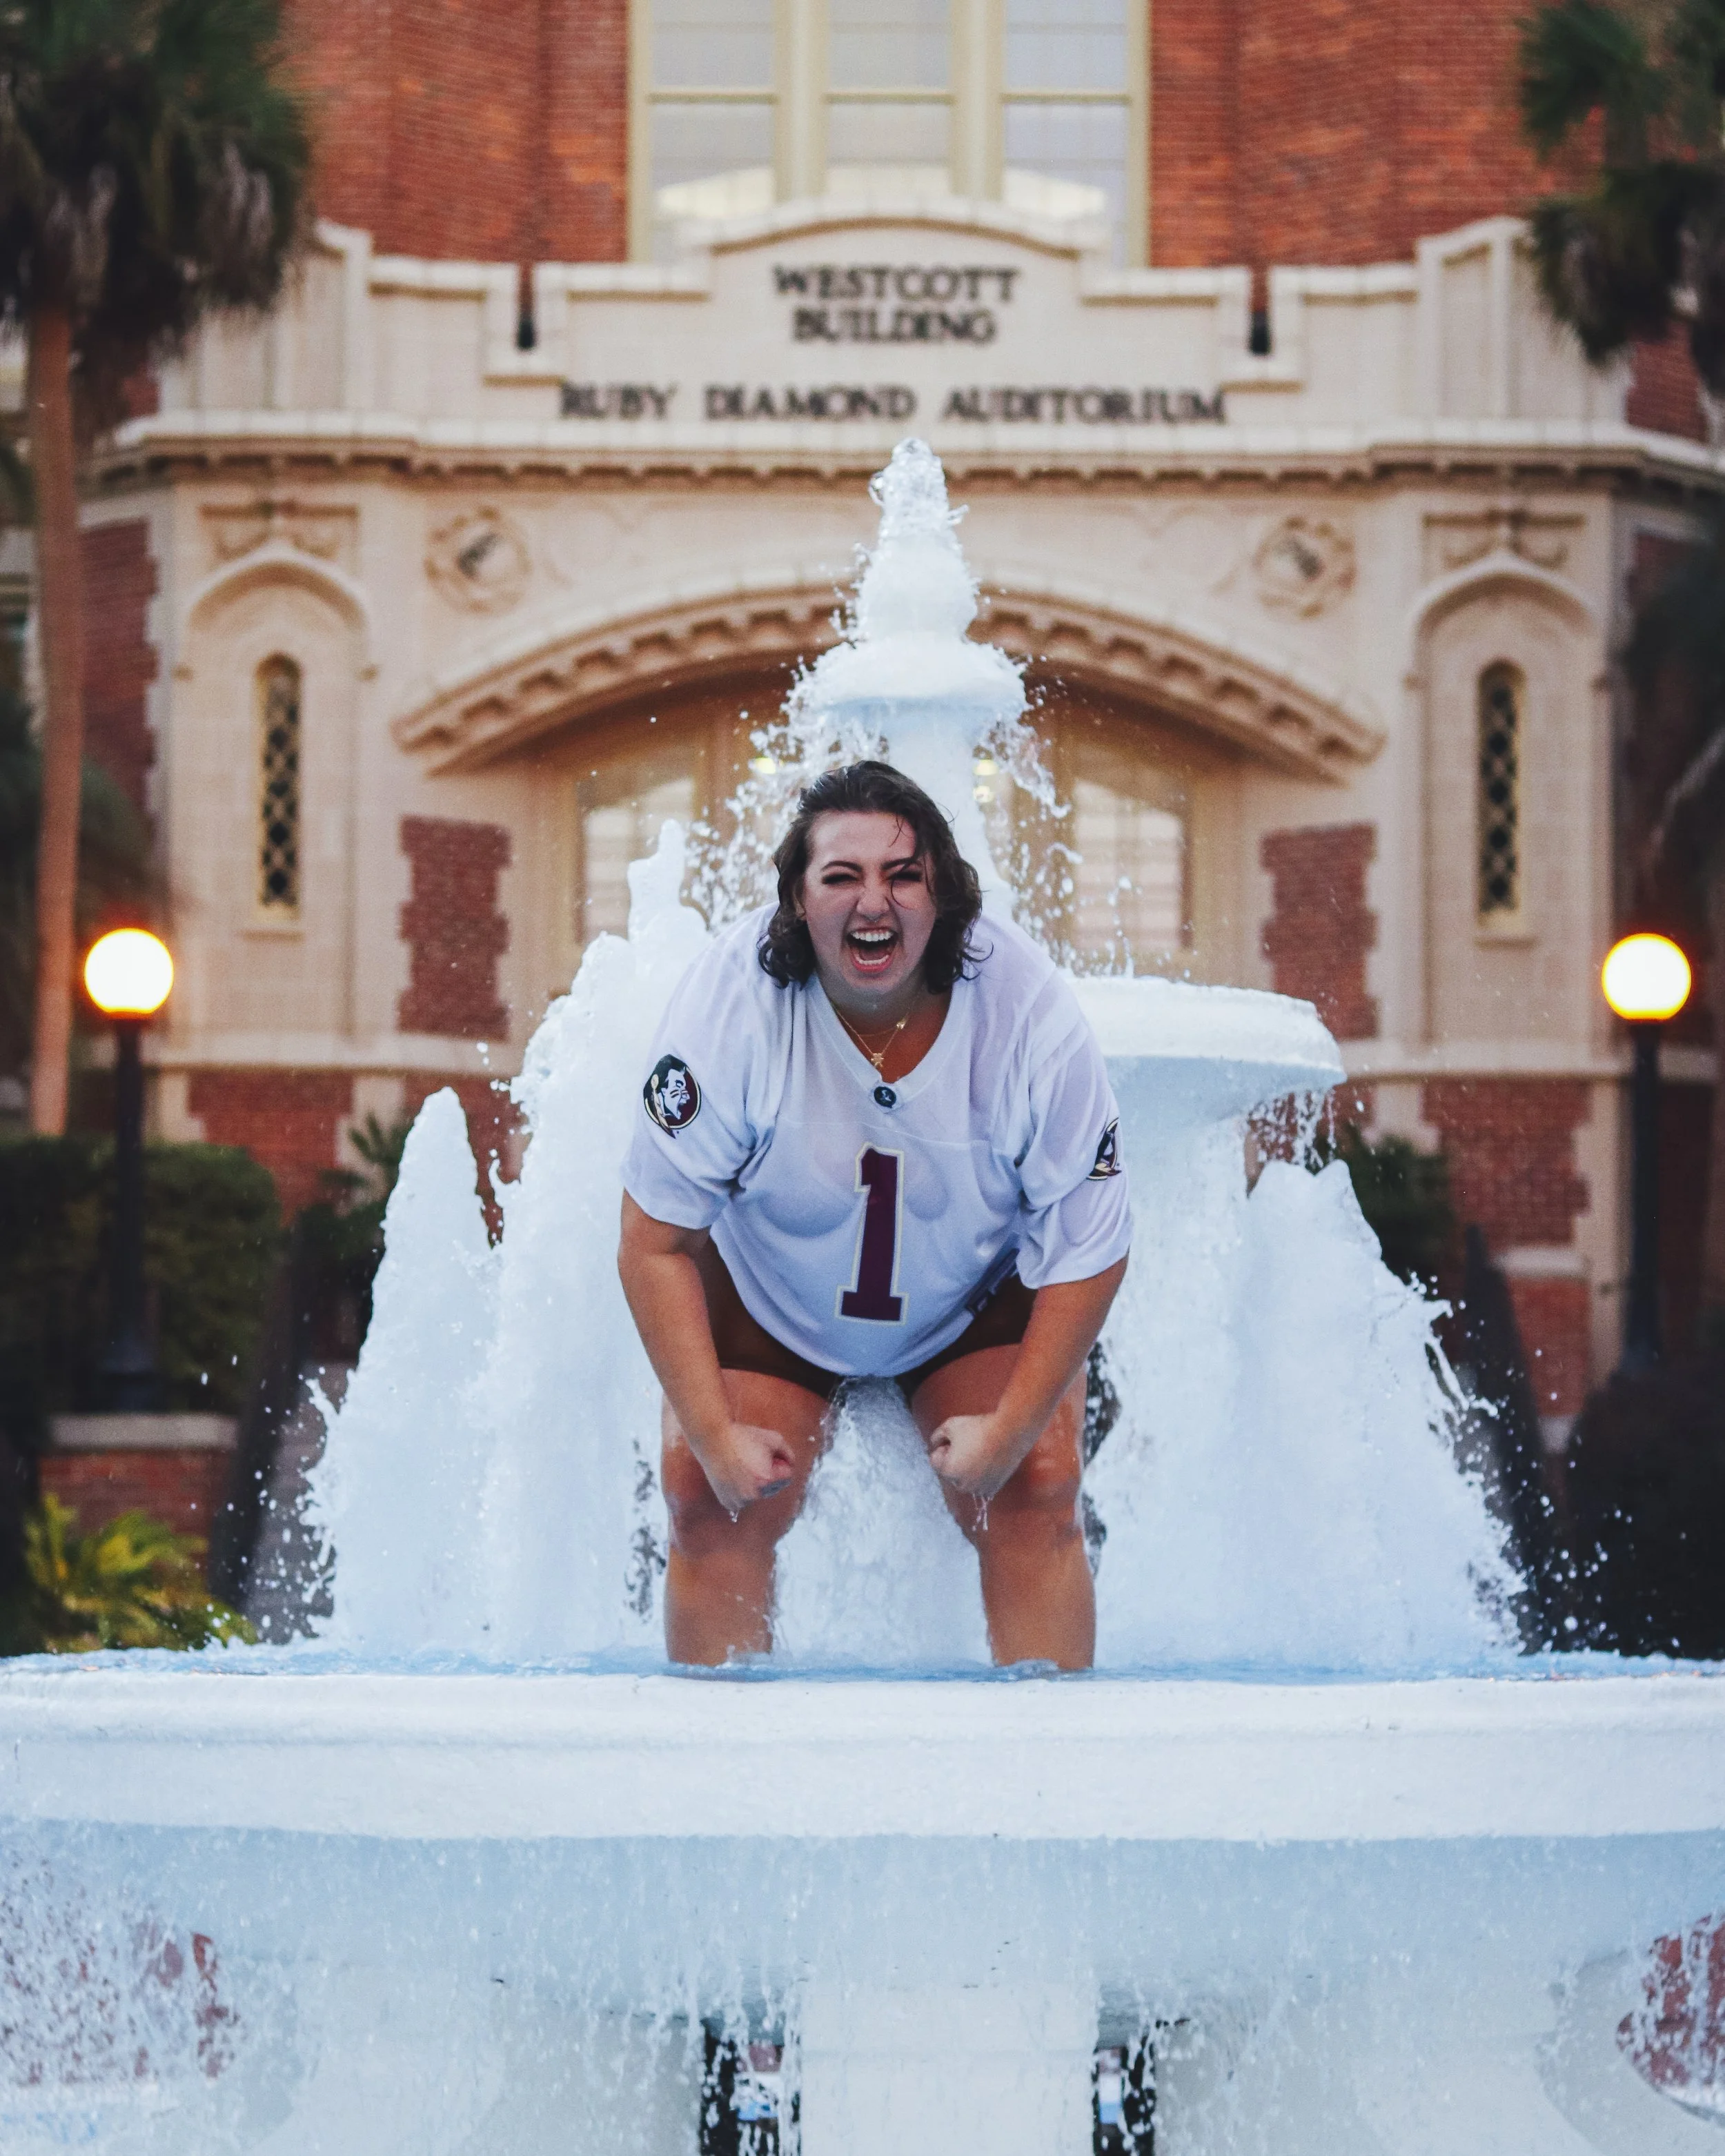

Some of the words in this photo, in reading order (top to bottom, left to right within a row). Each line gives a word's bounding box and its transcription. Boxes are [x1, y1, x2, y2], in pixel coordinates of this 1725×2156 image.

[773, 265, 1018, 302] WESTCOTT
[792, 308, 996, 344] BUILDING
[561, 384, 677, 419] RUBY
[705, 384, 917, 420] DIAMOND
[943, 386, 1227, 423] AUDITORIUM
[835, 1142, 909, 1325] 1
